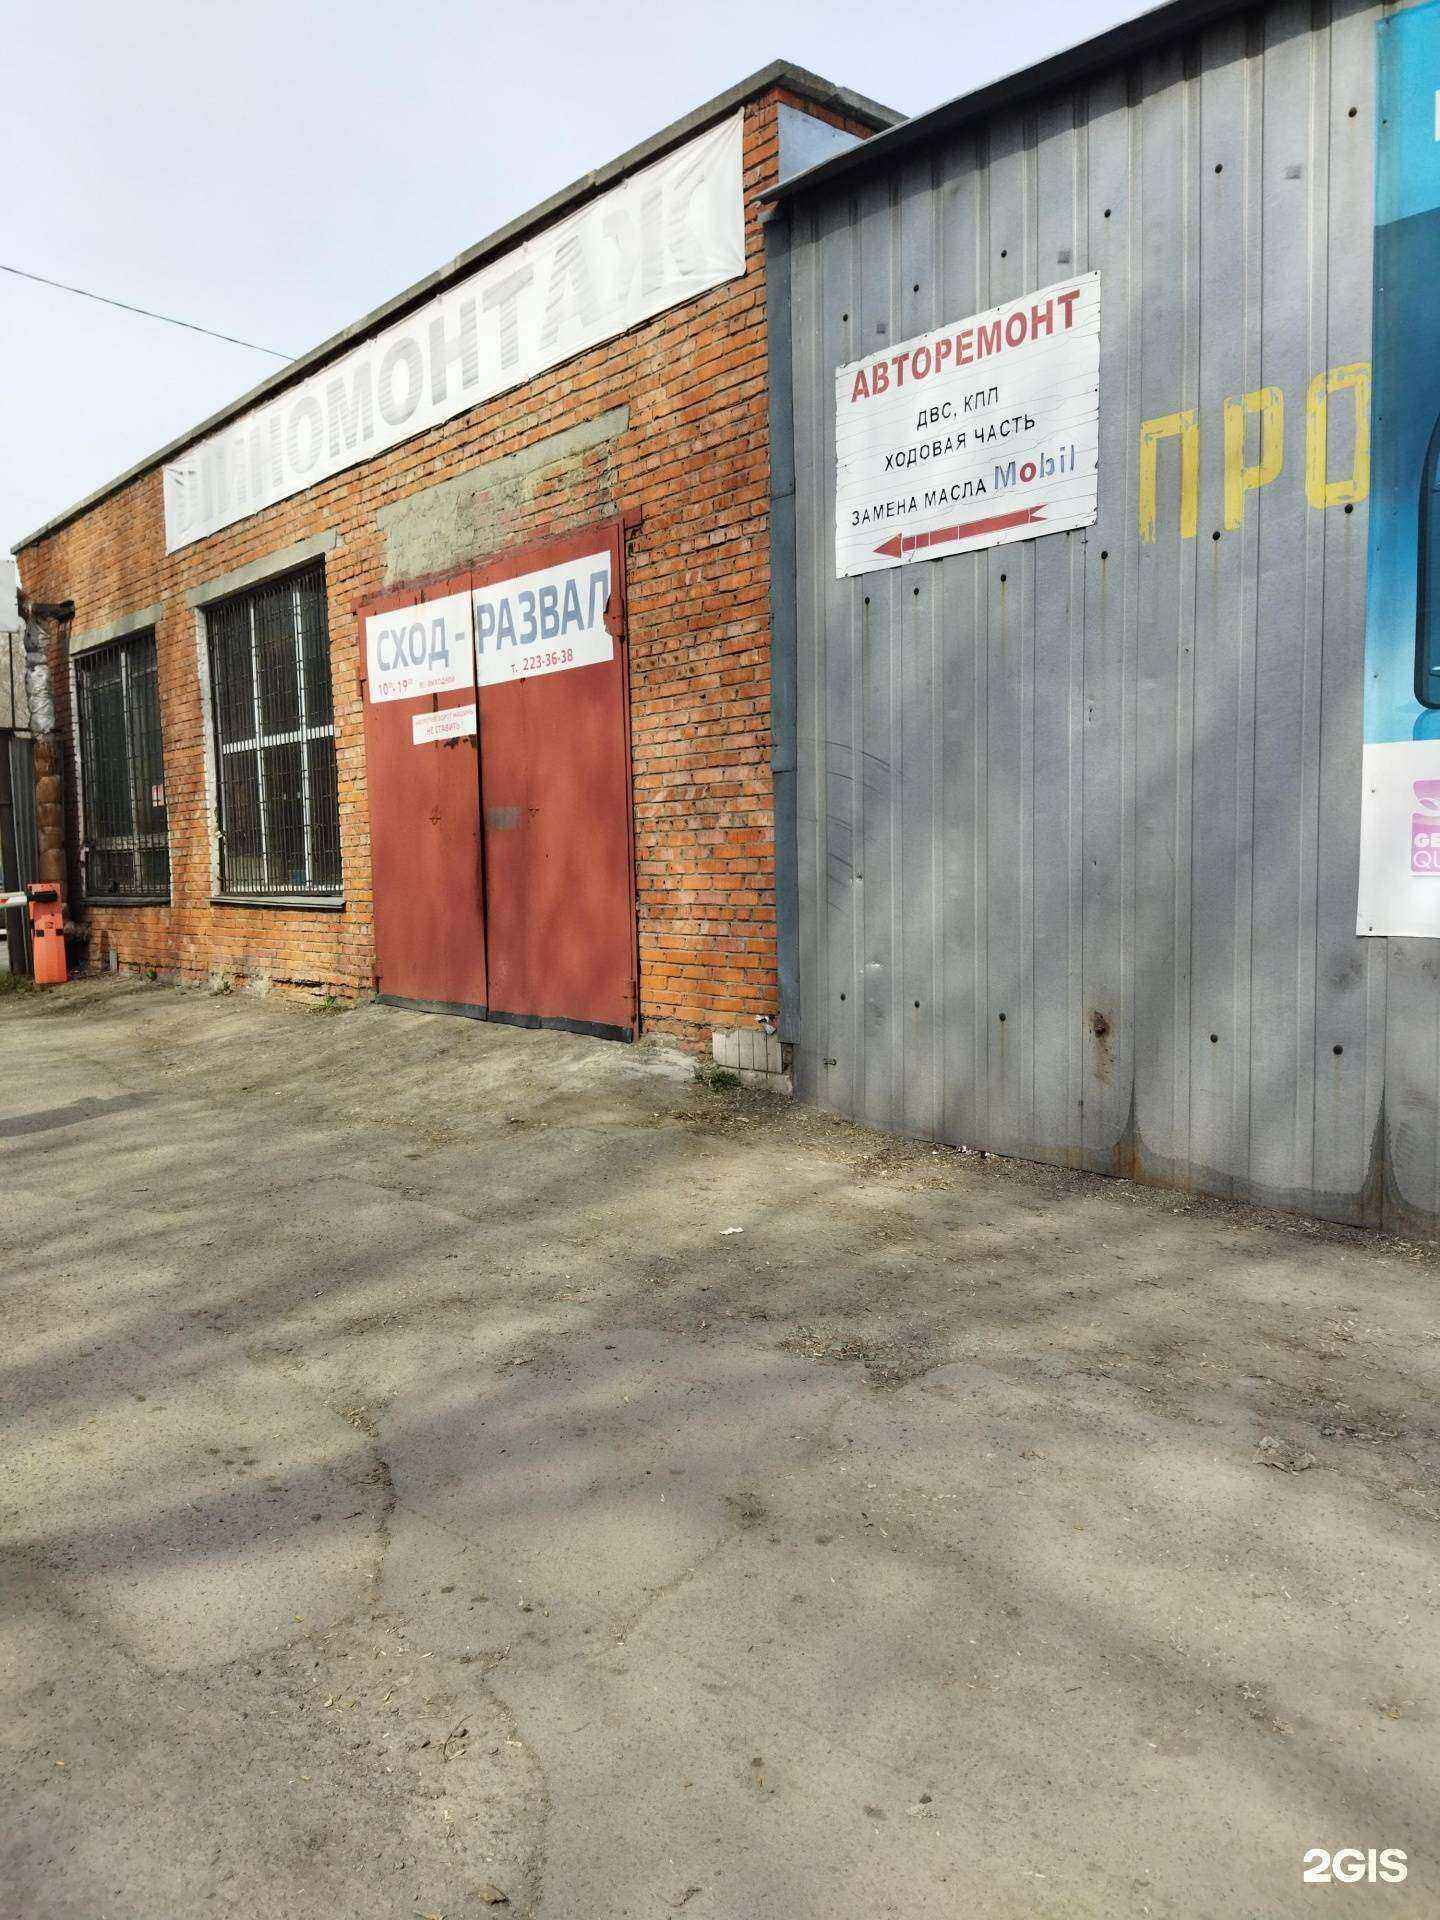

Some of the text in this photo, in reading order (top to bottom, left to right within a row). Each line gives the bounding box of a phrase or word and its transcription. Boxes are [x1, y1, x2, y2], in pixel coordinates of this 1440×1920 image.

[851, 288, 1081, 403] АВТОРЕМОНТ
[916, 386, 999, 431] ДВС, КПП
[884, 413, 1036, 472] ХОДОВАЯ ЧАСТЬ
[851, 444, 1076, 526] ЗАМЕНА МАСЛА Mobil
[522, 648, 573, 671] 223-36-38
